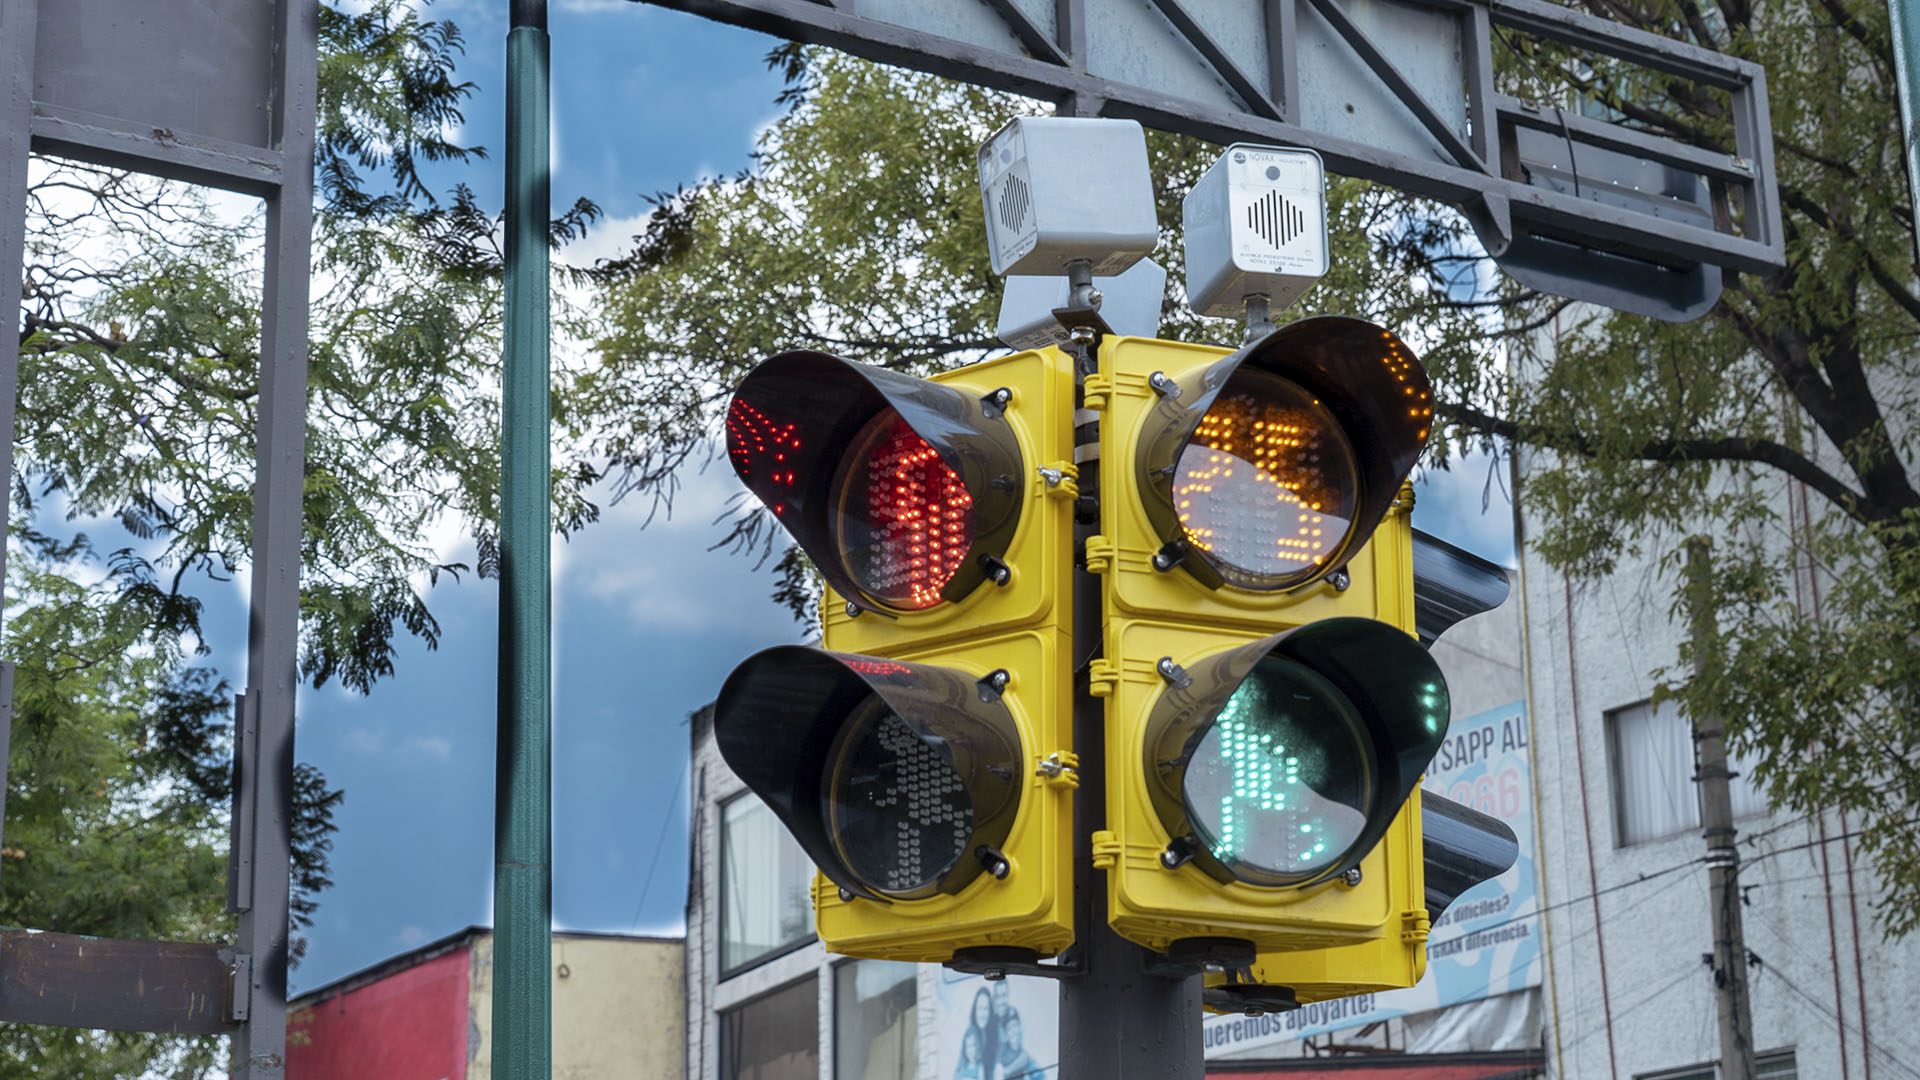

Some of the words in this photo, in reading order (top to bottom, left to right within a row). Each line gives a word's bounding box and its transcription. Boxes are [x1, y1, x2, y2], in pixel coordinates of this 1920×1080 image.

[1248, 152, 1275, 161] NOVAX
[1502, 716, 1528, 754] AL
[1204, 1012, 1281, 1048] ueremos
